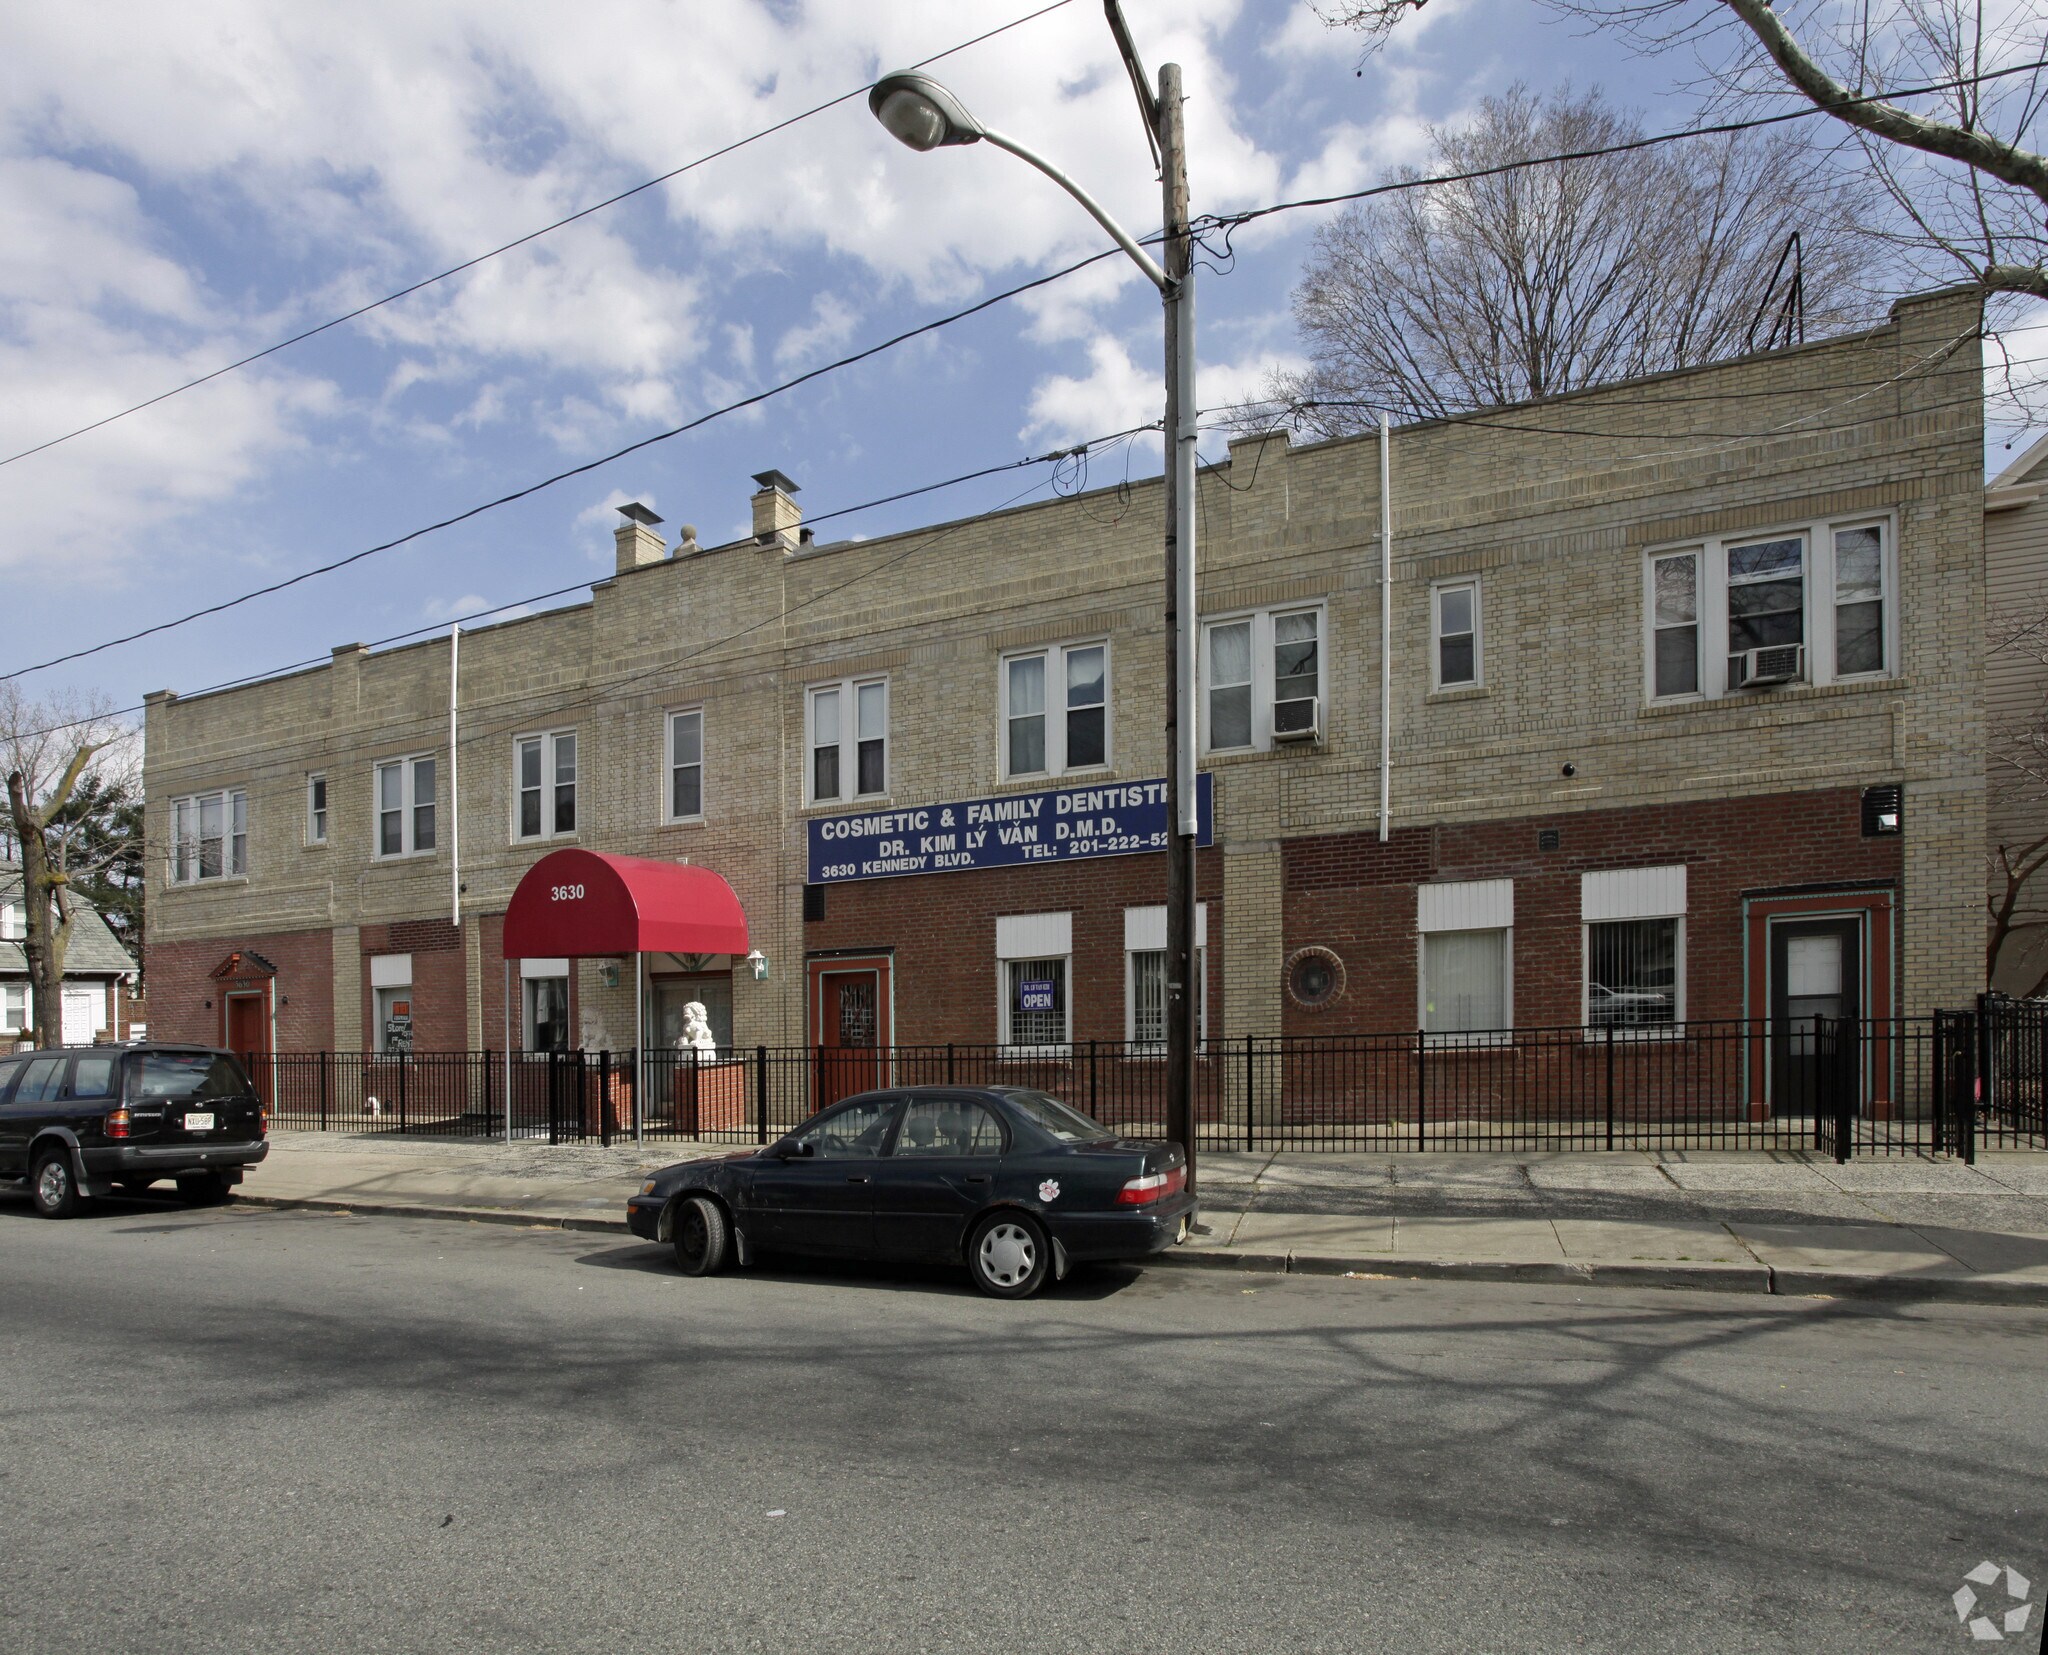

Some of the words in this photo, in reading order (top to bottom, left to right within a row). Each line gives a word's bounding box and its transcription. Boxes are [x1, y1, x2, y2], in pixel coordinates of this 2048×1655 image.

[821, 811, 929, 841] COSMETIC
[940, 808, 956, 828] &
[967, 798, 1044, 825] FAMILY
[1056, 782, 1168, 815] DENTIST
[879, 840, 910, 858] DR.
[920, 834, 956, 854] KIM
[965, 825, 988, 849] LÝ
[1055, 817, 1122, 840] D.M.D.
[1021, 844, 1058, 859] TEL:
[1069, 832, 1168, 855] 201-222-52
[821, 861, 856, 879] 3630
[862, 856, 928, 875] KENNEDY
[934, 851, 975, 868] BLVD.
[551, 884, 585, 901] 3630
[1023, 993, 1051, 1008] OPEN
